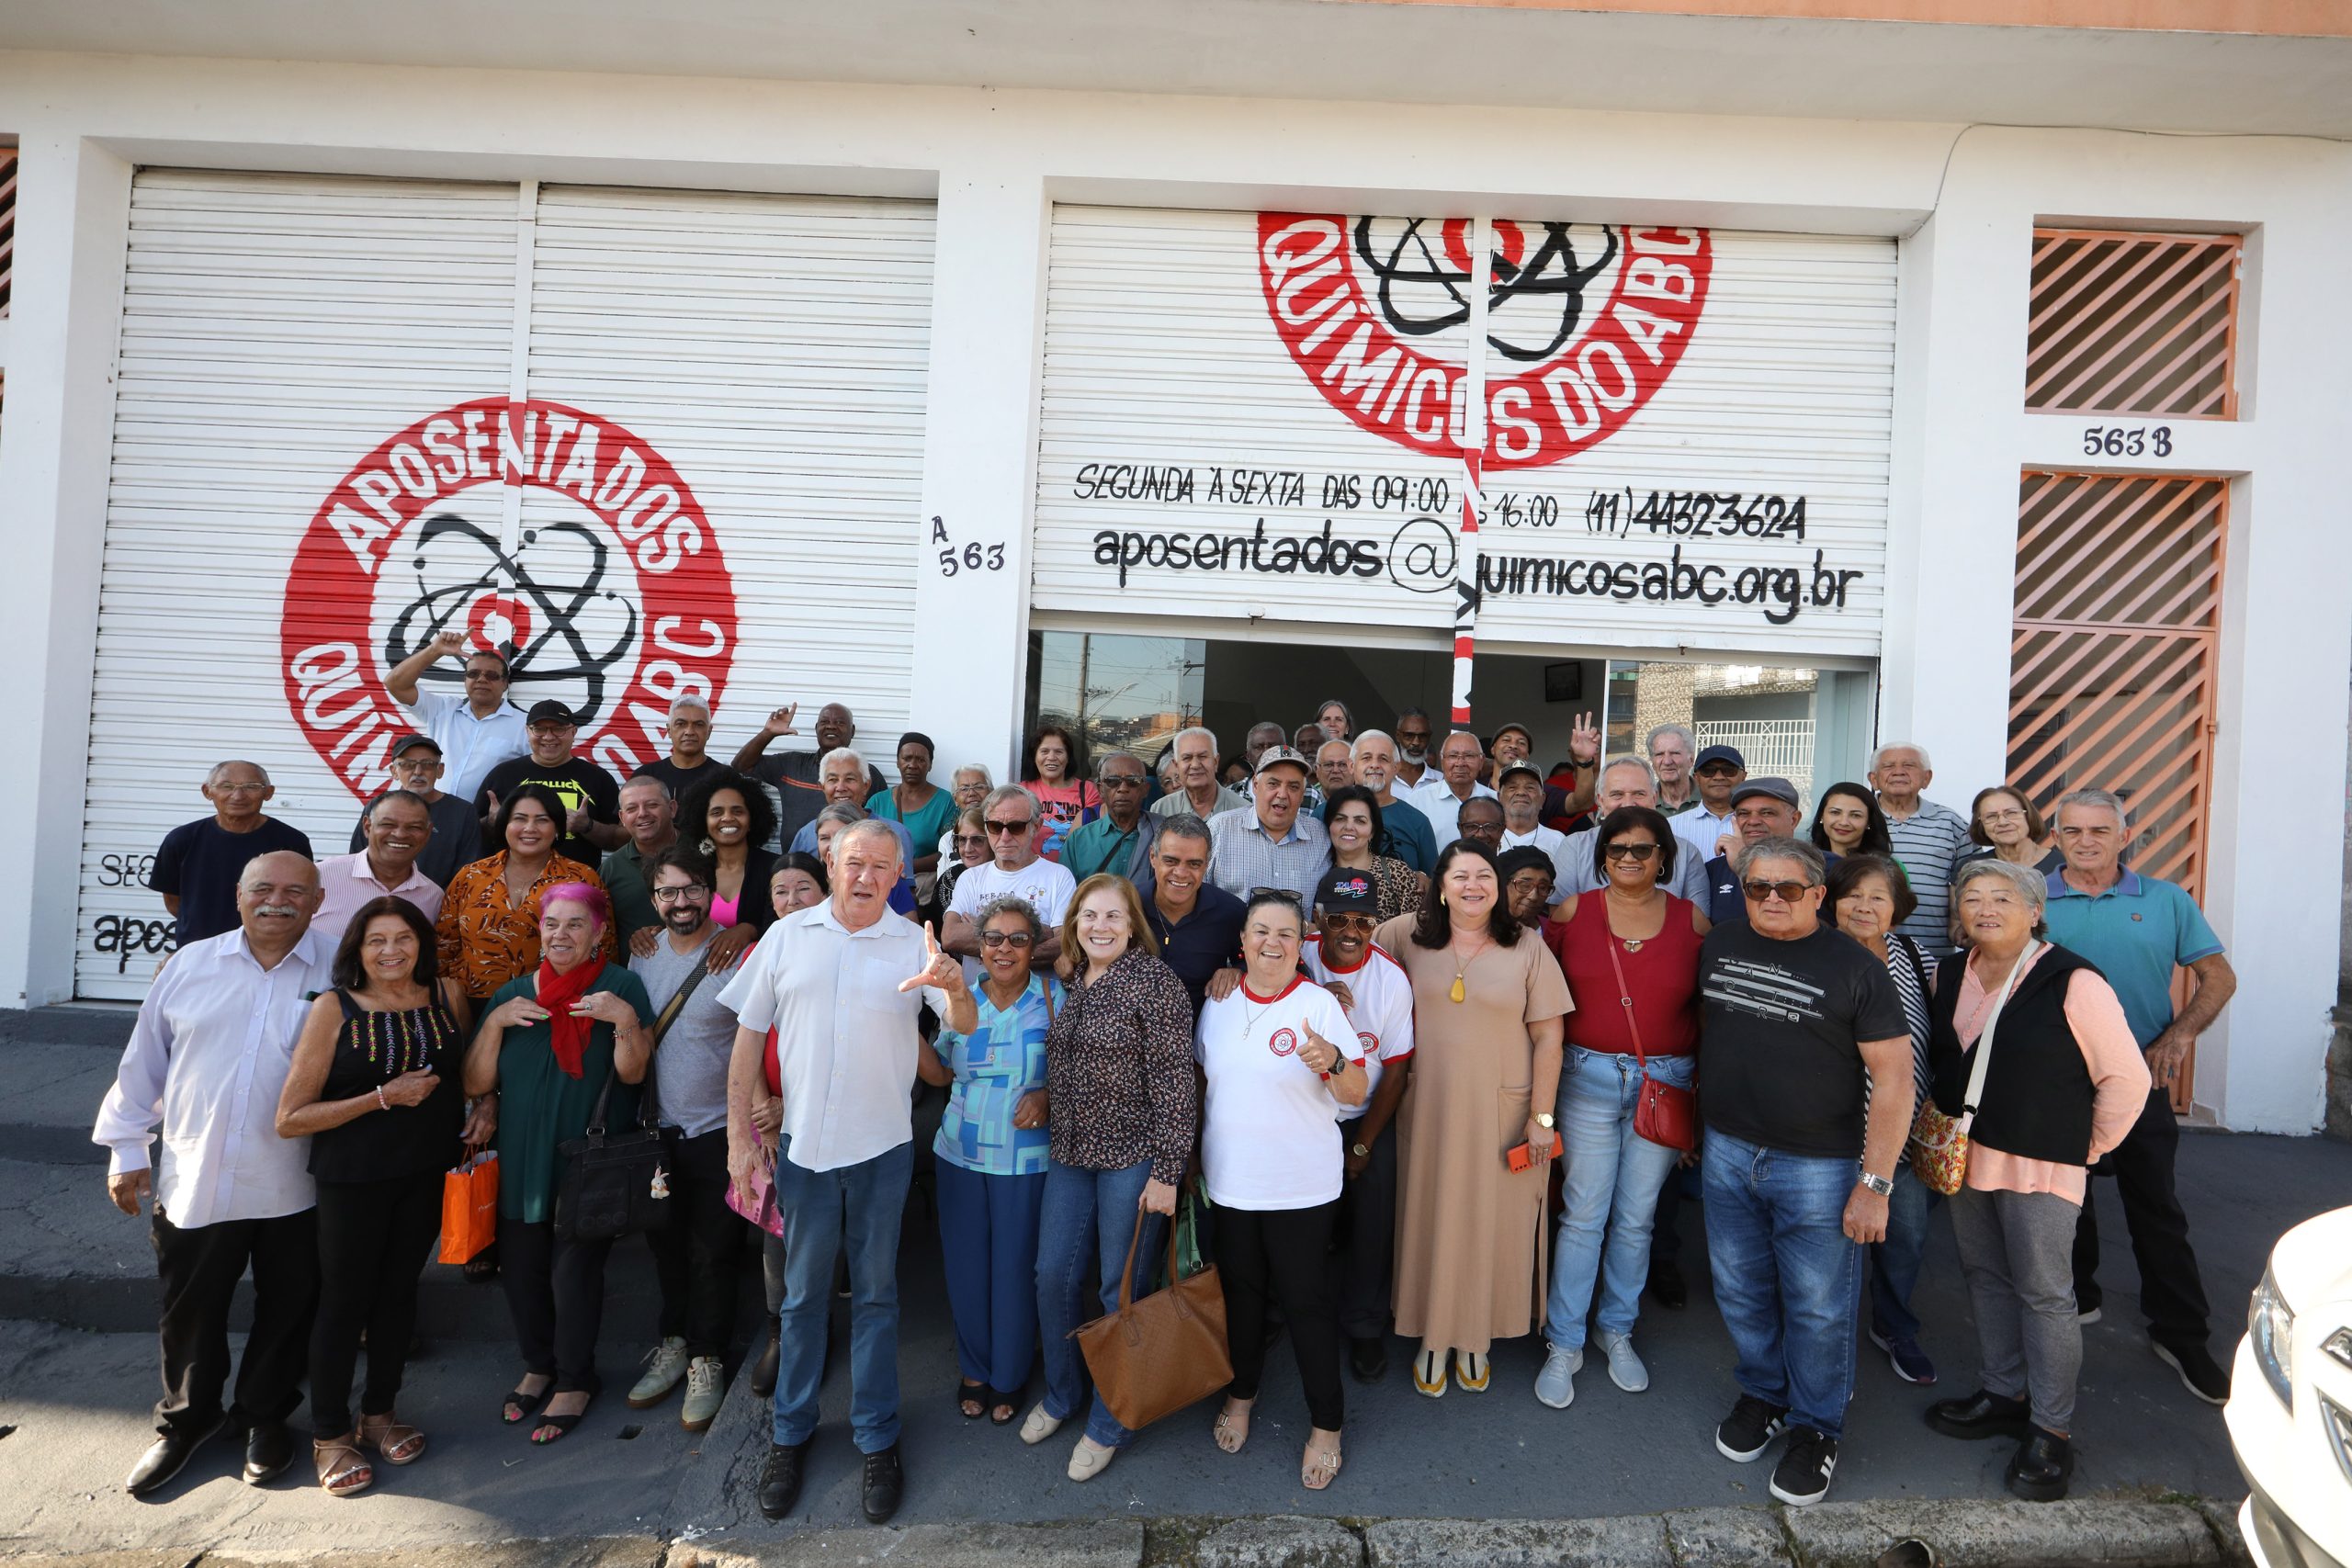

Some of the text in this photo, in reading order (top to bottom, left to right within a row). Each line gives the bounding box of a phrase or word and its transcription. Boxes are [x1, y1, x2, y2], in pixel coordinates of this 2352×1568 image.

[1541, 341, 1636, 443] DO
[2084, 425, 2145, 457] 563
[326, 410, 704, 577] APOSENTADOS
[1073, 463, 1193, 503] SEGUNDA
[1229, 468, 1305, 507] SEXTA
[1321, 474, 1362, 510] DAS
[1372, 475, 1449, 513] 09:00
[1494, 492, 1559, 527] 16:00
[932, 515, 949, 545] A
[939, 541, 1005, 577] 563
